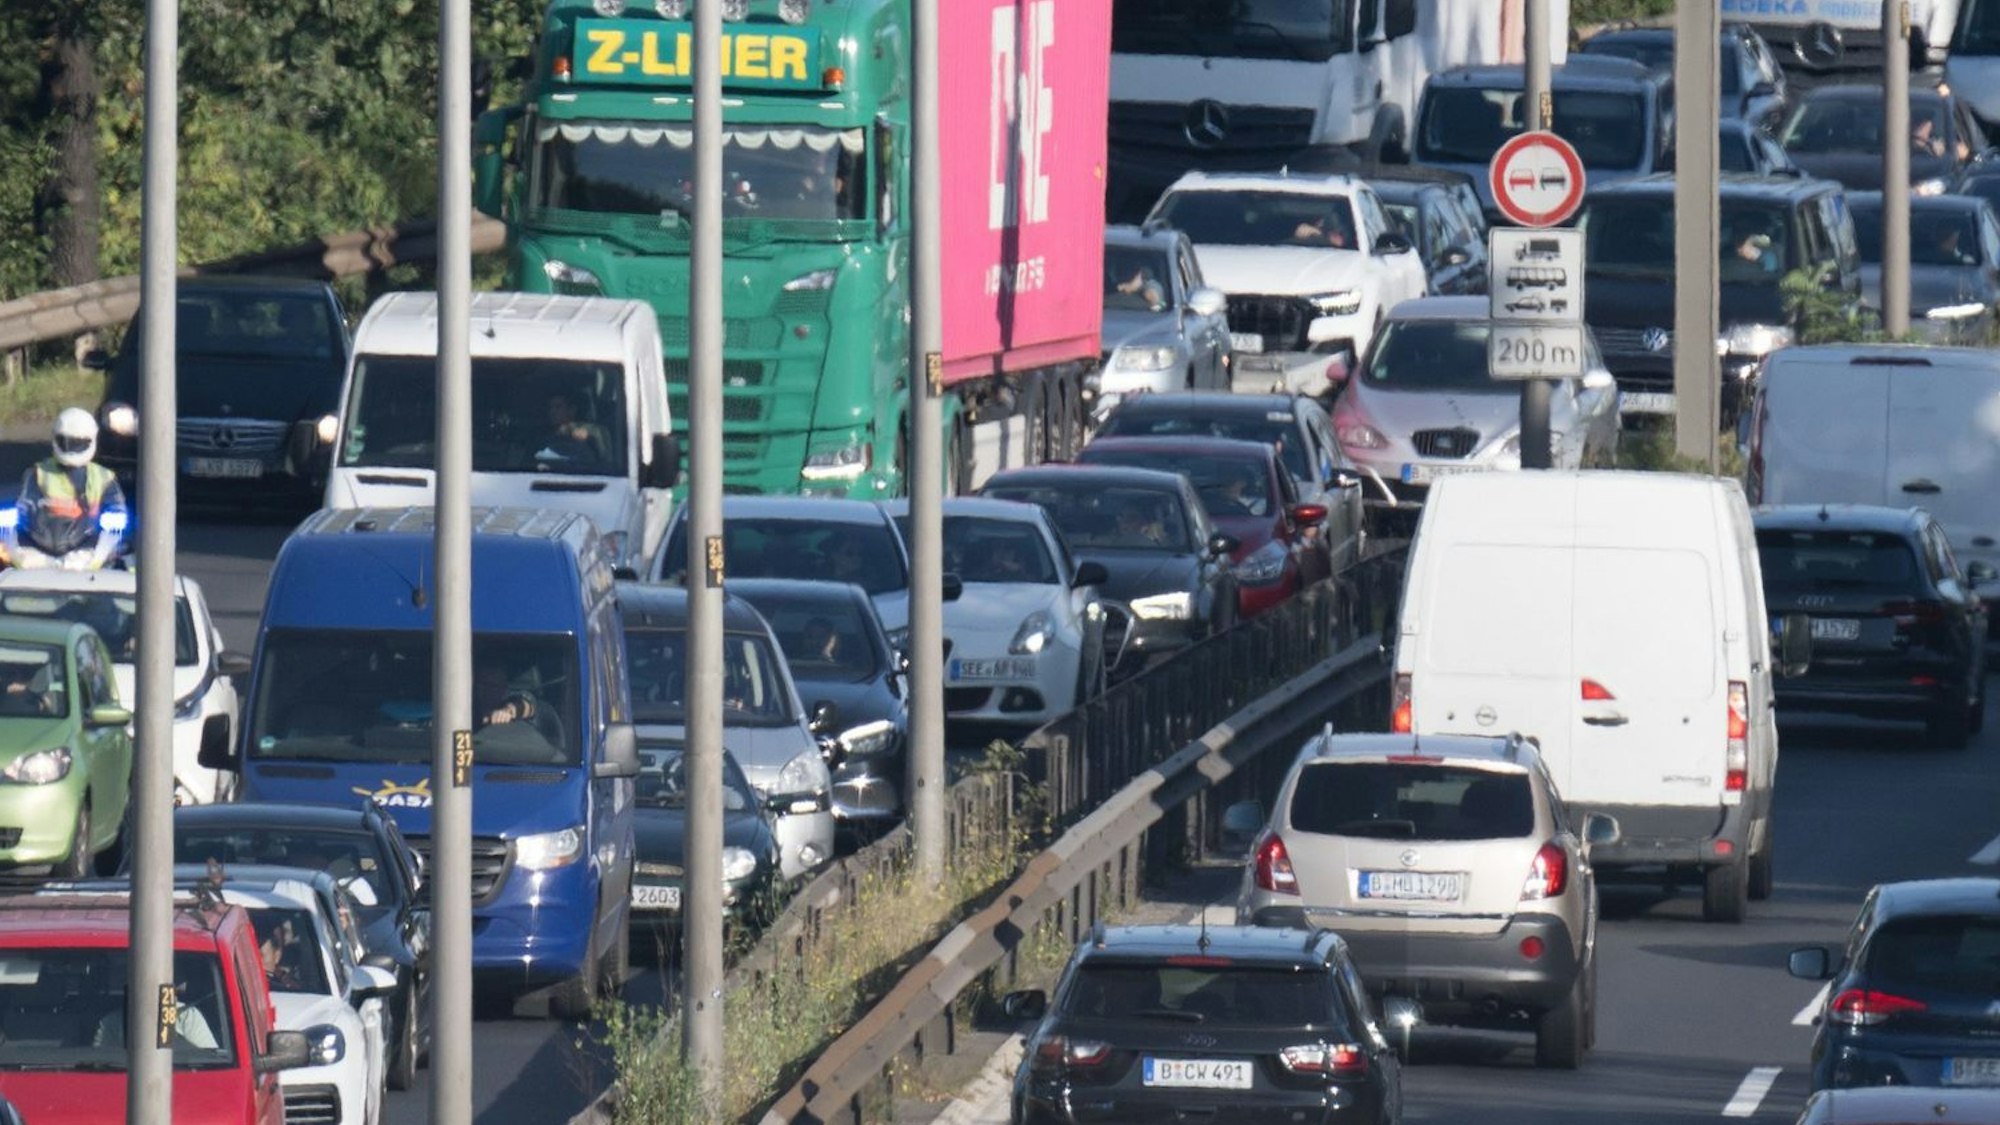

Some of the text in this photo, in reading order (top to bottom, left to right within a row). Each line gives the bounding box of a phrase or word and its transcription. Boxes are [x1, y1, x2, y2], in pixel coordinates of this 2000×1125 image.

[586, 29, 808, 80] Z-LIER
[1499, 338, 1575, 362] 200 m
[709, 538, 722, 554] 21
[456, 732, 470, 749] 21
[456, 749, 473, 767] 37
[1371, 875, 1381, 892] B
[639, 889, 678, 904] 2603
[161, 987, 175, 1005] 21
[161, 1007, 177, 1024] 38
[1161, 1064, 1244, 1081] B CW 491
